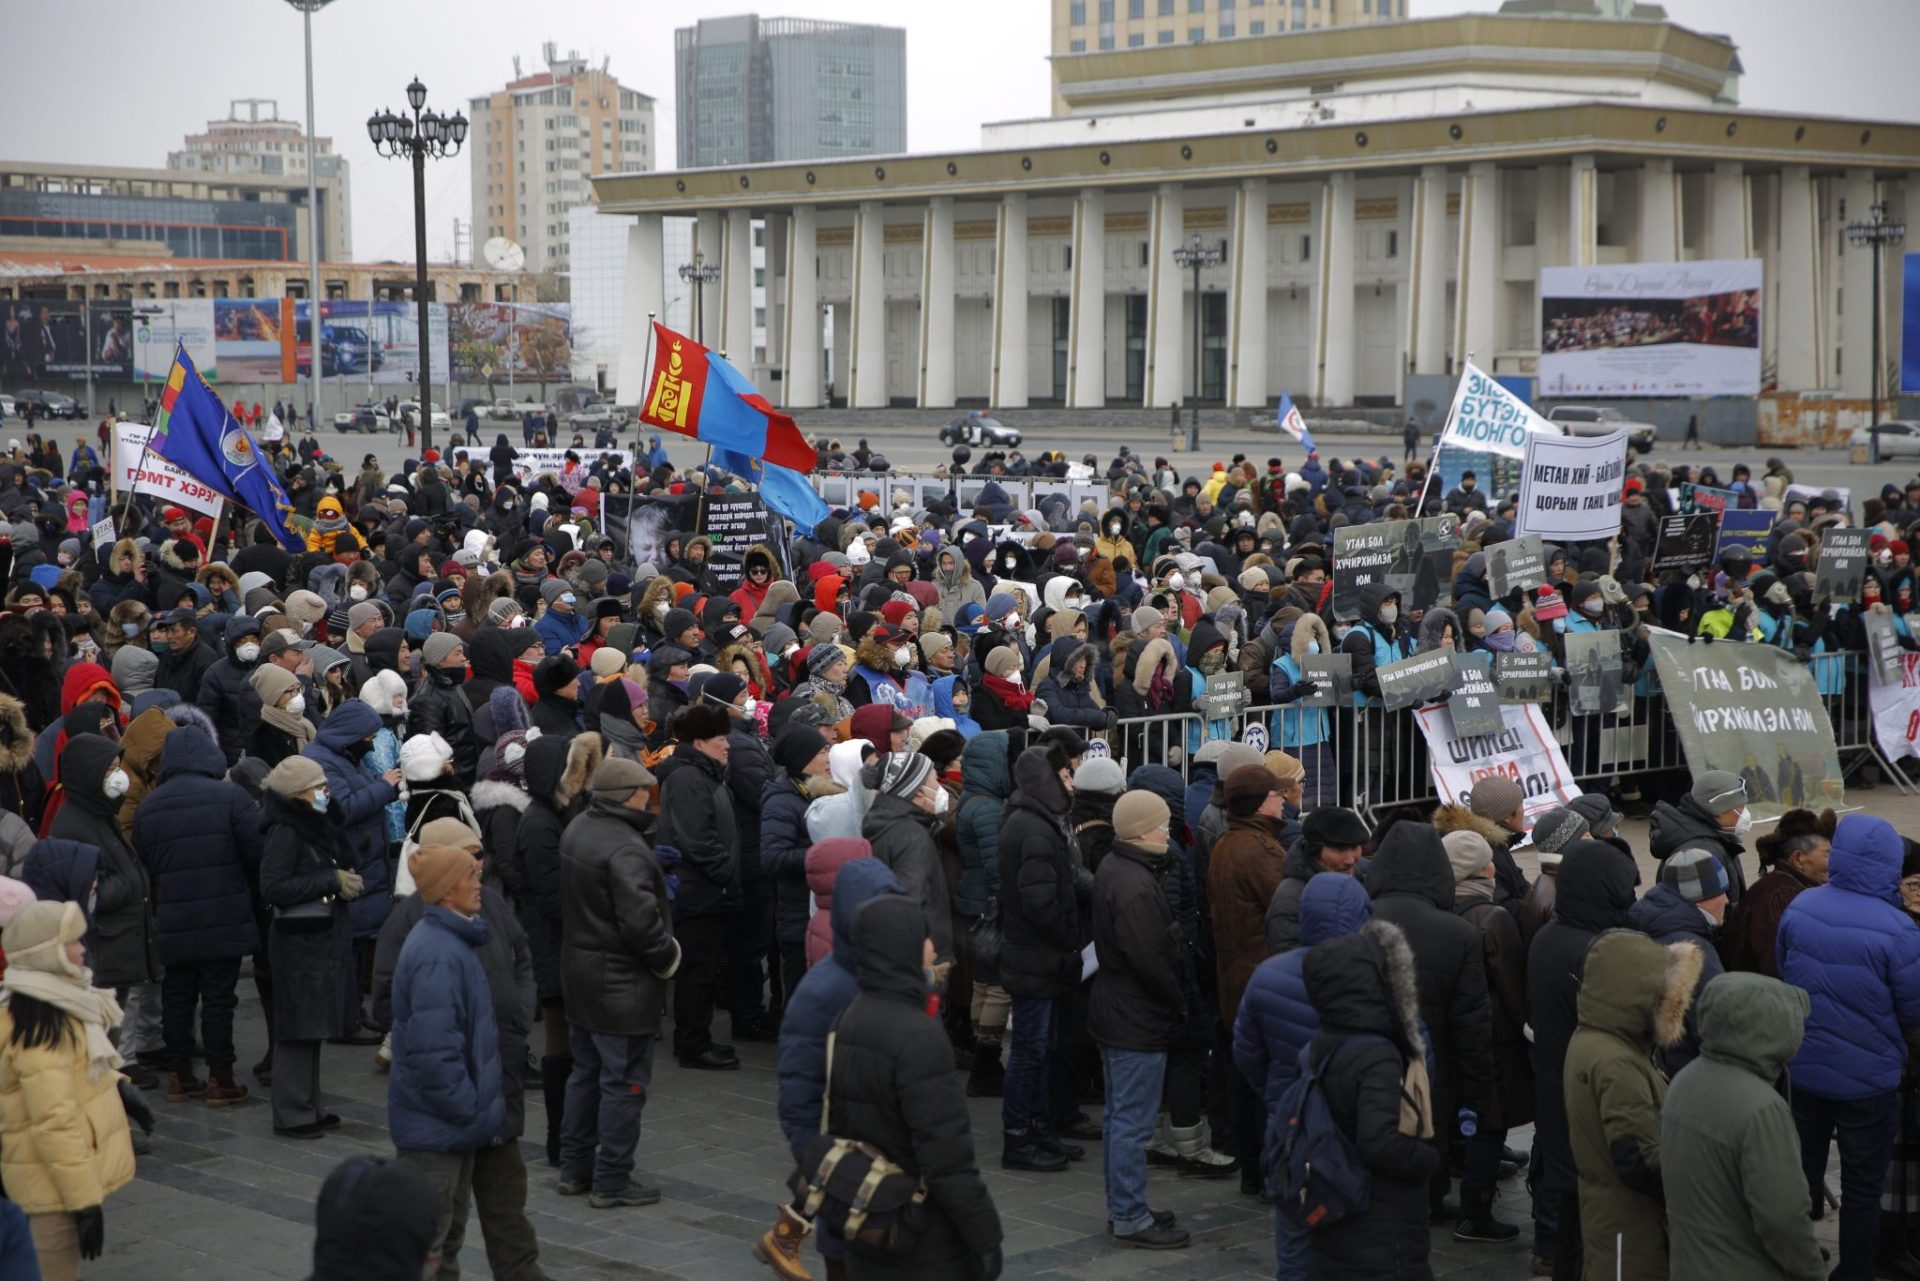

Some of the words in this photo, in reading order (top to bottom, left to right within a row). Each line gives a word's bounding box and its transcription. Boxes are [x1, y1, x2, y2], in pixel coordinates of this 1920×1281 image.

[1461, 396, 1528, 425] БҮТЭН
[1456, 416, 1526, 446] МОНГО
[1534, 464, 1569, 484] МЕТАН
[1571, 464, 1590, 485] ХИЙ
[127, 468, 175, 488] ГЭМТ
[179, 481, 217, 504] ХЭРЭГ
[1536, 494, 1578, 511] ЦОРЫН
[1583, 494, 1604, 510] ГАНЦ
[1346, 538, 1366, 551] УТАА
[1368, 535, 1384, 548] БОЛ
[1336, 552, 1392, 570] ХҮЧИРХИЙЛЭЛ
[1356, 574, 1371, 586] ЮМ
[1467, 669, 1483, 681] БОЛ
[1466, 696, 1481, 708] ЮМ
[1689, 702, 1792, 735] ИРХИЙЛЭЛ
